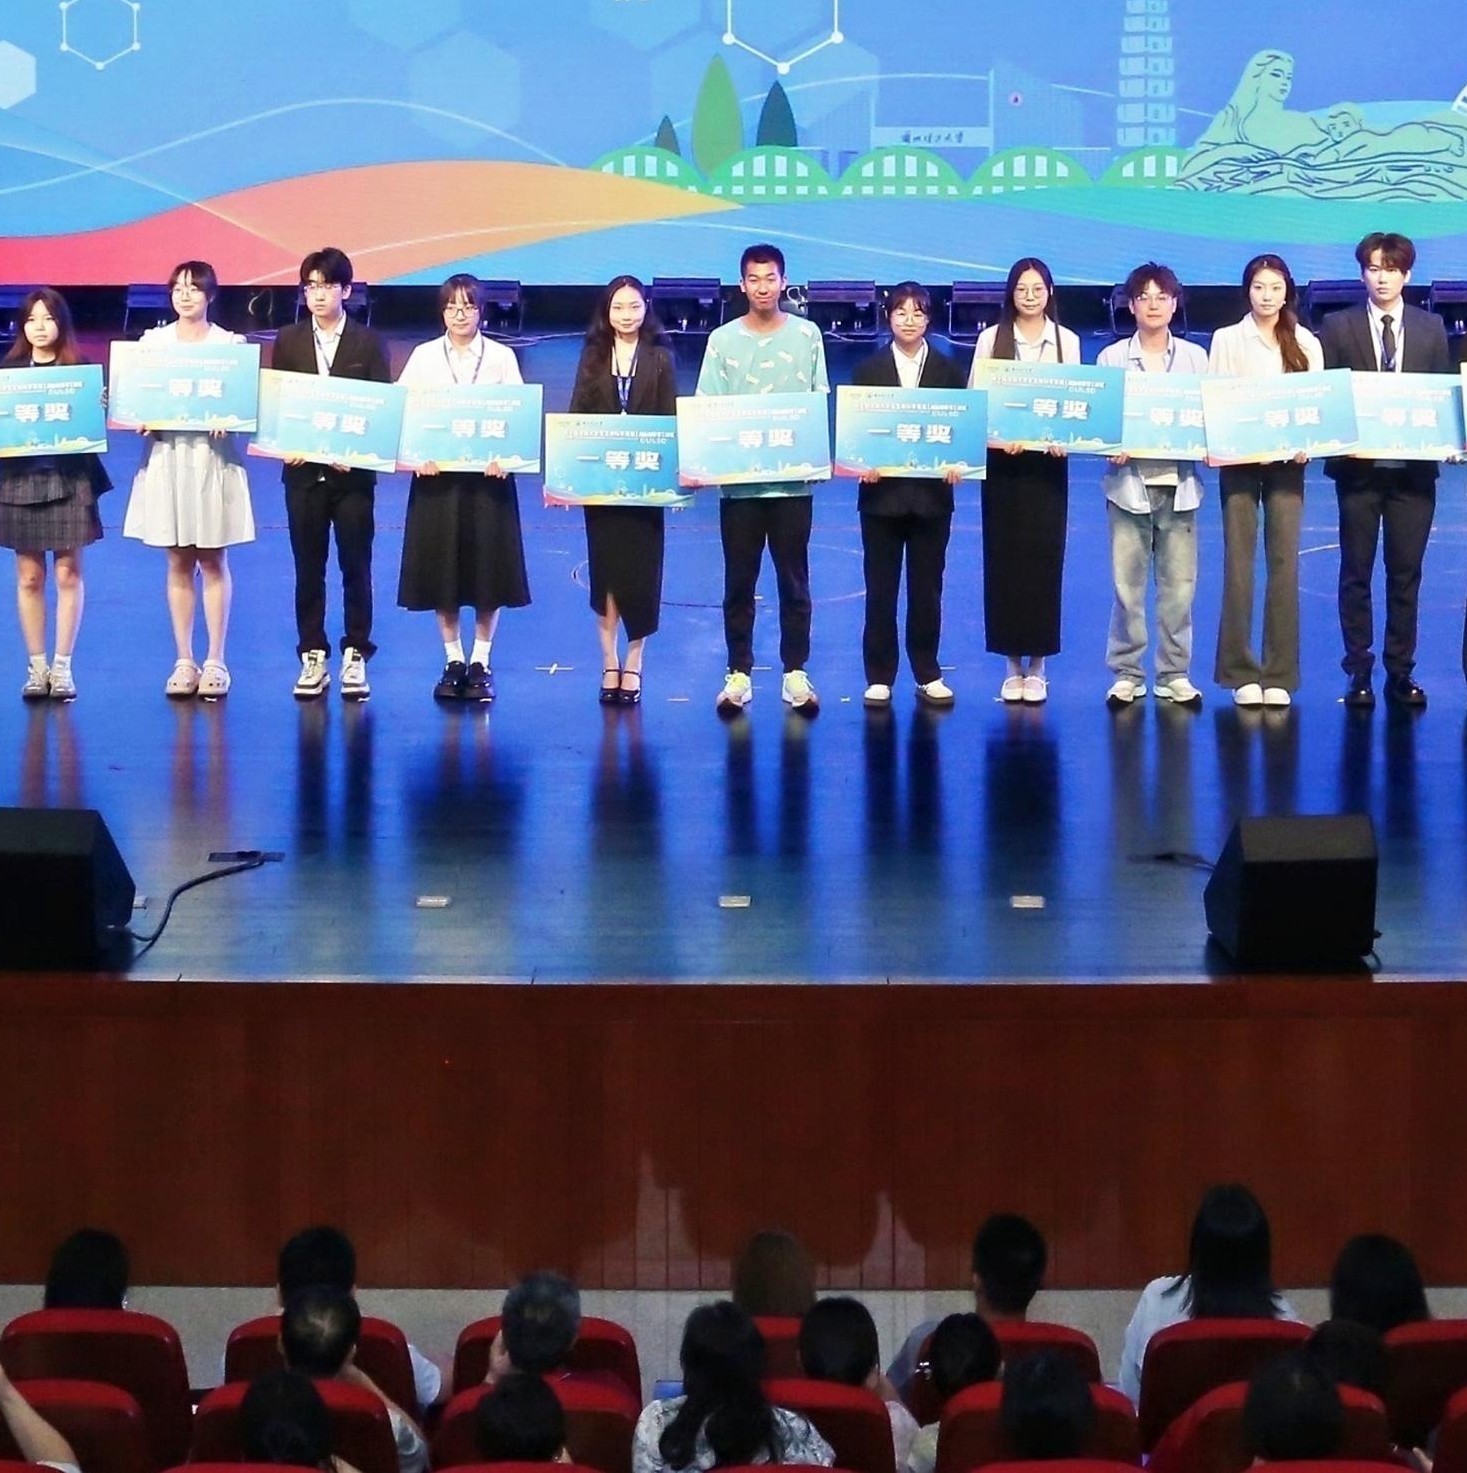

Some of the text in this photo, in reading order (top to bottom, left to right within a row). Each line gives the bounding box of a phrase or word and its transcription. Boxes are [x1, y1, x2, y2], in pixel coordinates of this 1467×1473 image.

[1004, 399, 1088, 419] 一等奖
[868, 424, 952, 444] 一等奖
[577, 451, 660, 471] 一等奖
